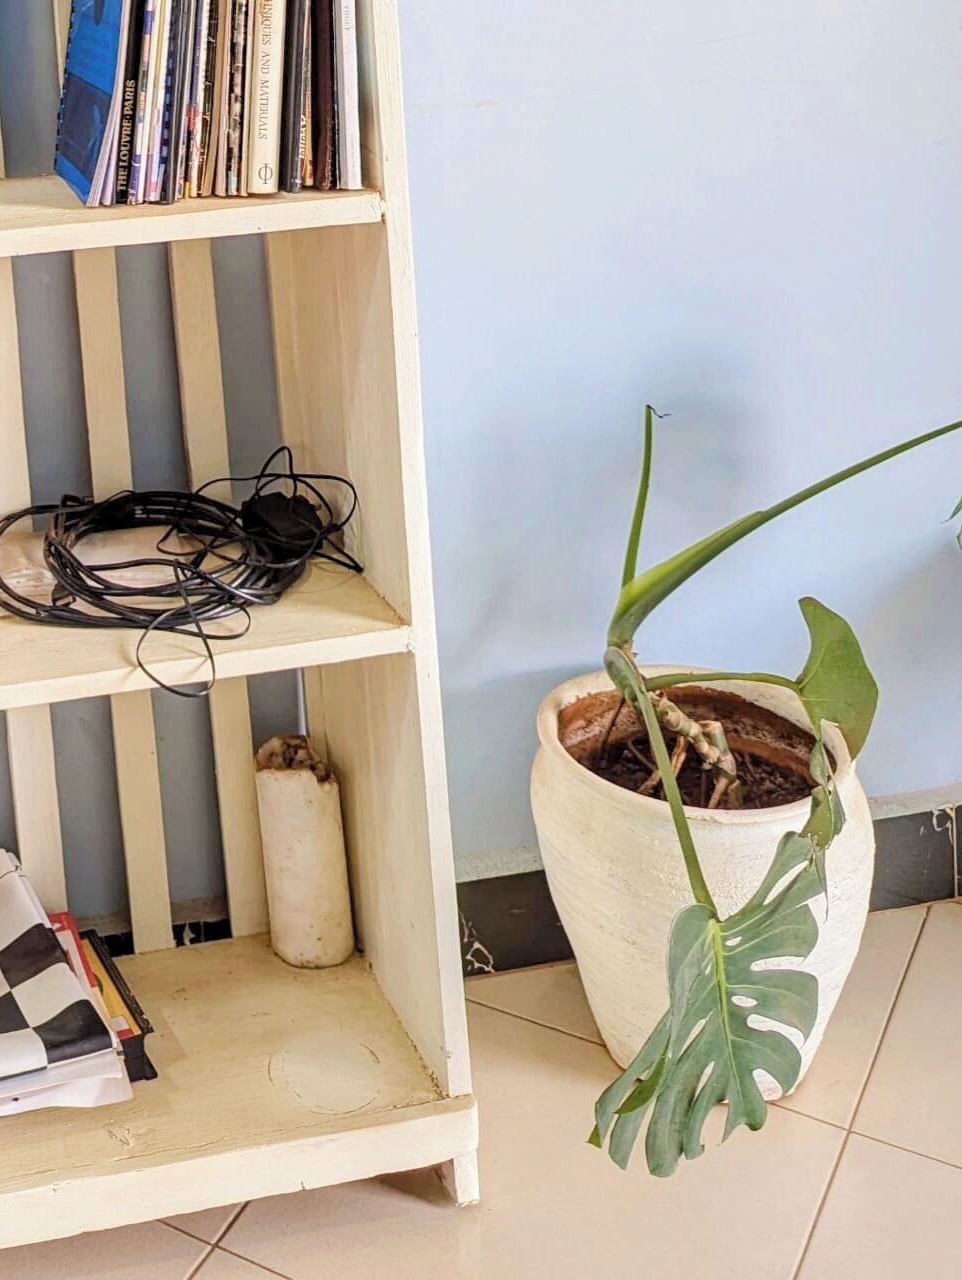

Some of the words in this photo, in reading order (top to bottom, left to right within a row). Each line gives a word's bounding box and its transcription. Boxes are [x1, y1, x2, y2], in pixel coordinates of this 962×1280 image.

[260, 51, 270, 74] AND
[123, 79, 135, 114] PARIS
[256, 78, 270, 140] MATERIALS
[119, 119, 131, 166] LOUVRE
[117, 167, 127, 192] THE
